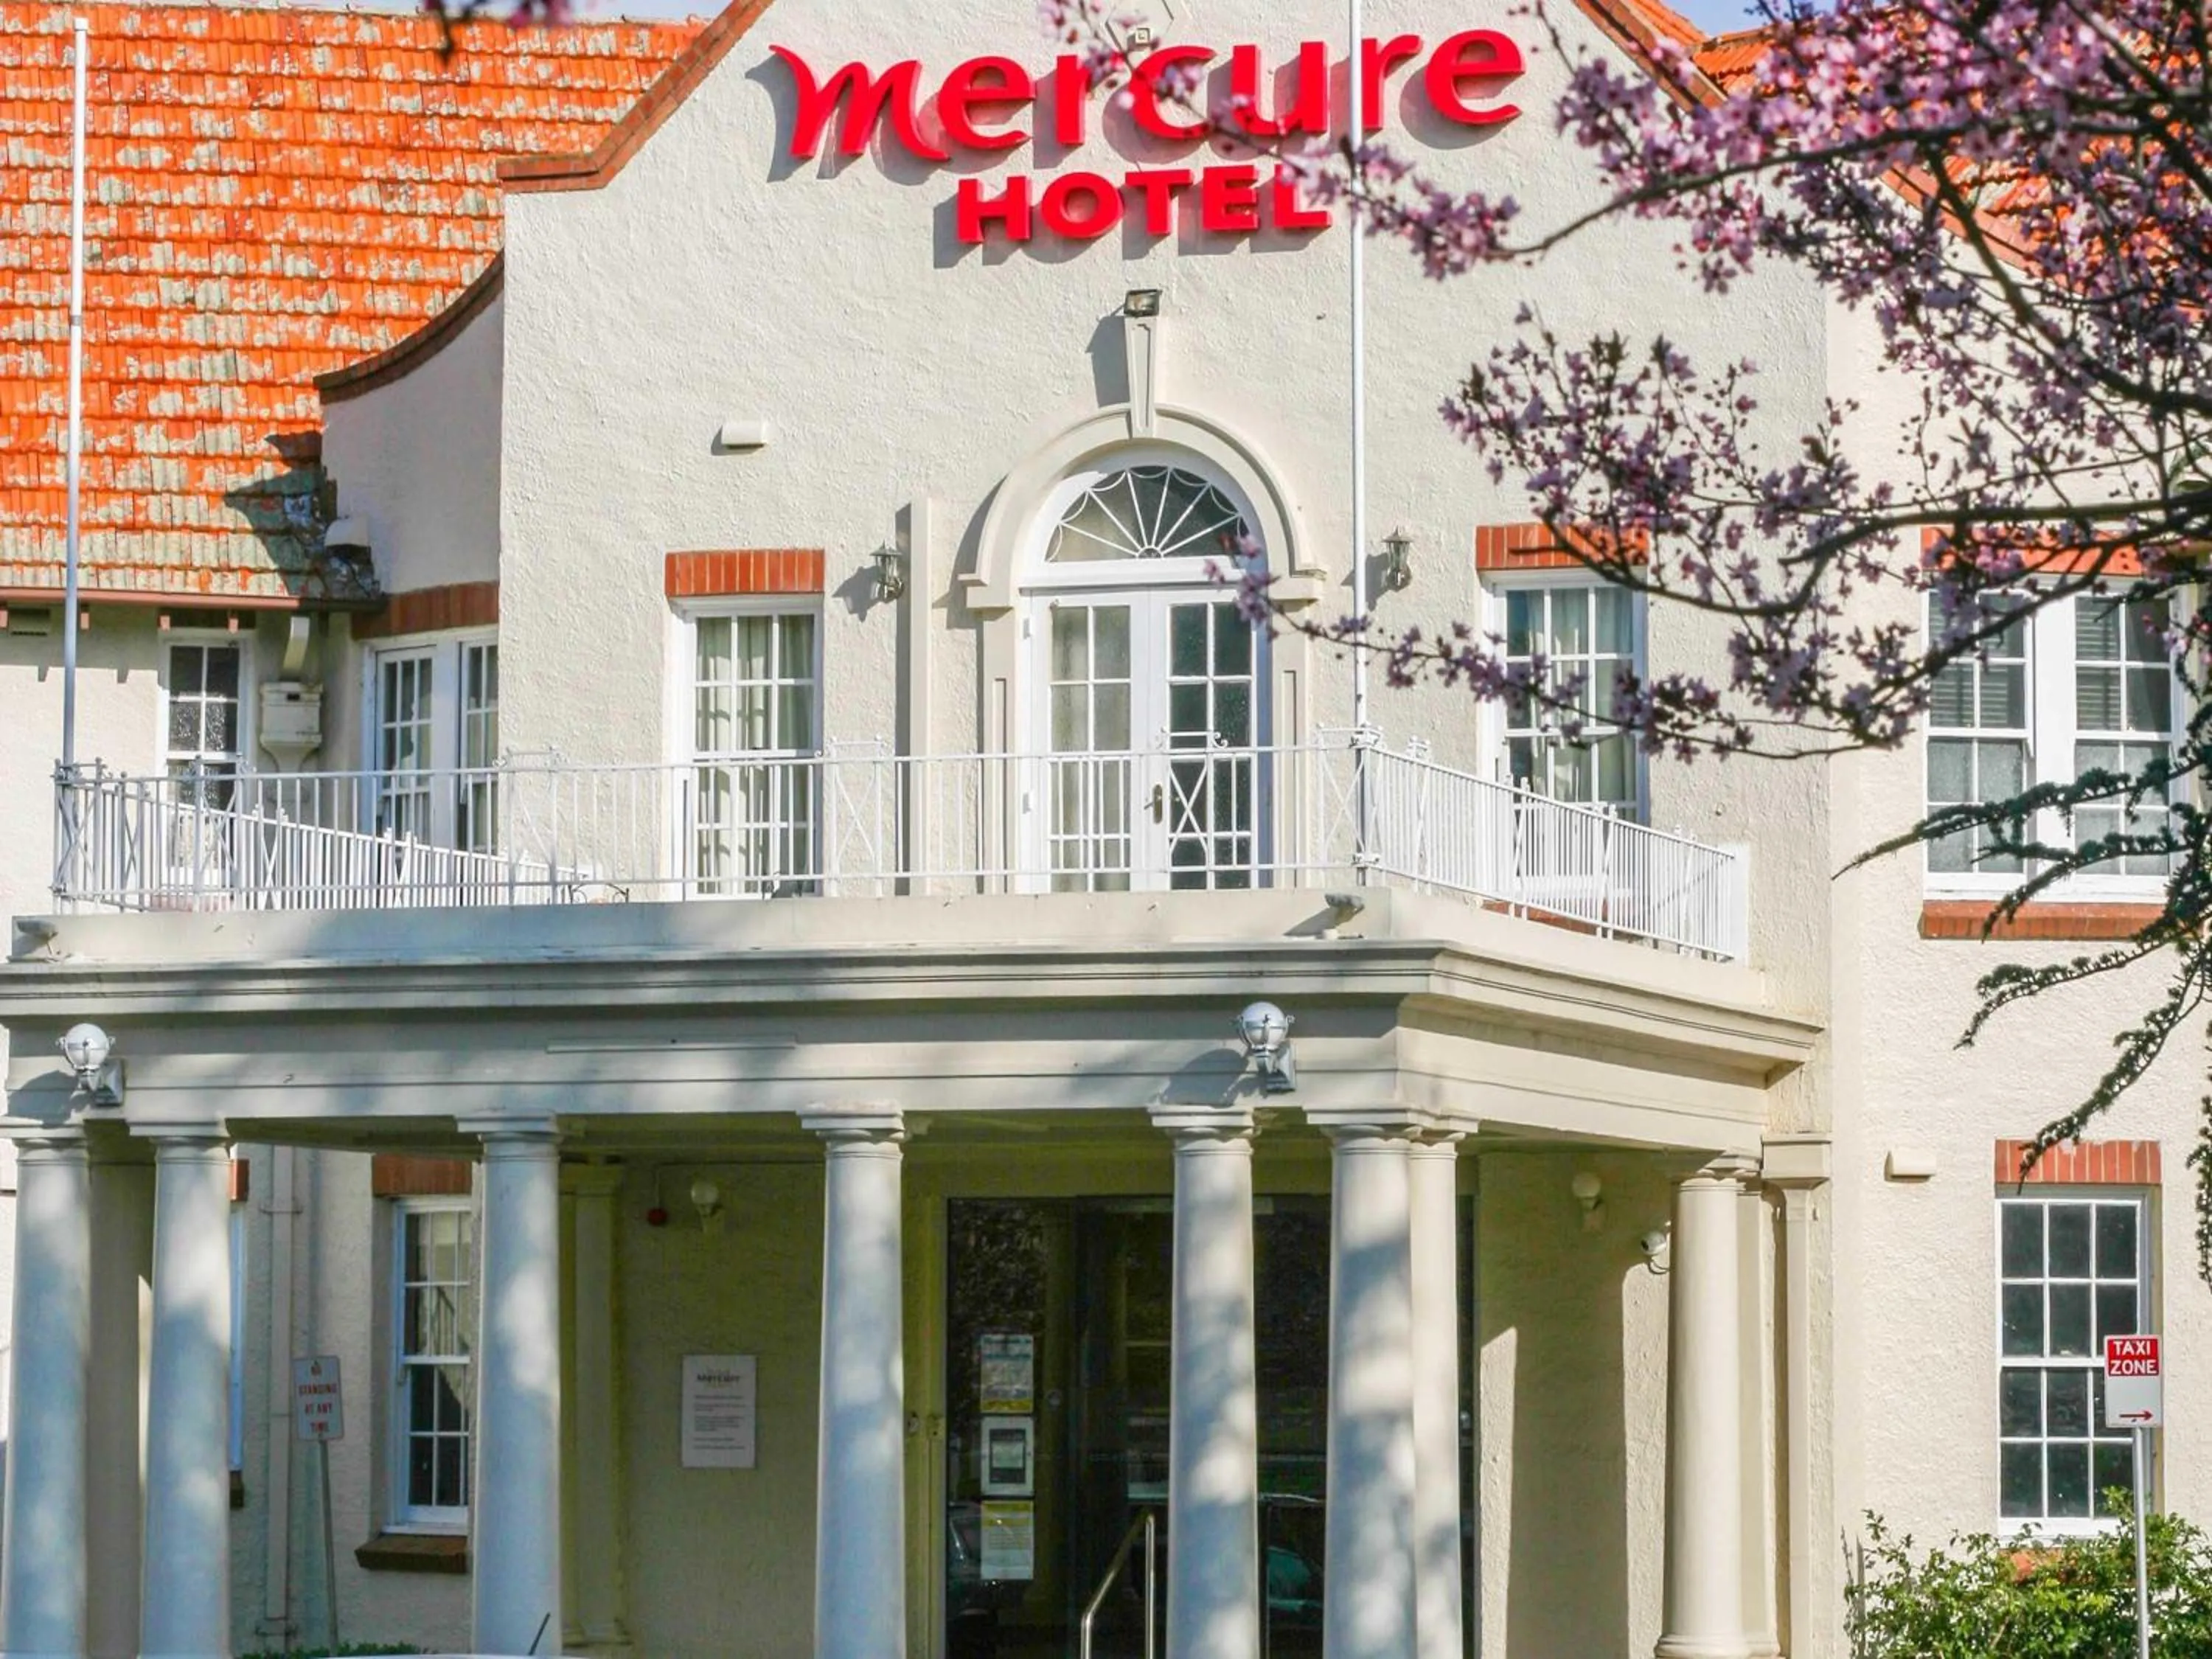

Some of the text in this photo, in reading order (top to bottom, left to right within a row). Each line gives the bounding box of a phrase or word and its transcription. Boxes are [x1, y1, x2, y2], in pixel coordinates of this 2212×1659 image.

[956, 164, 1331, 244] HOTEL
[2112, 1340, 2151, 1355] TAXI
[2110, 1360, 2157, 1374] ZONE
